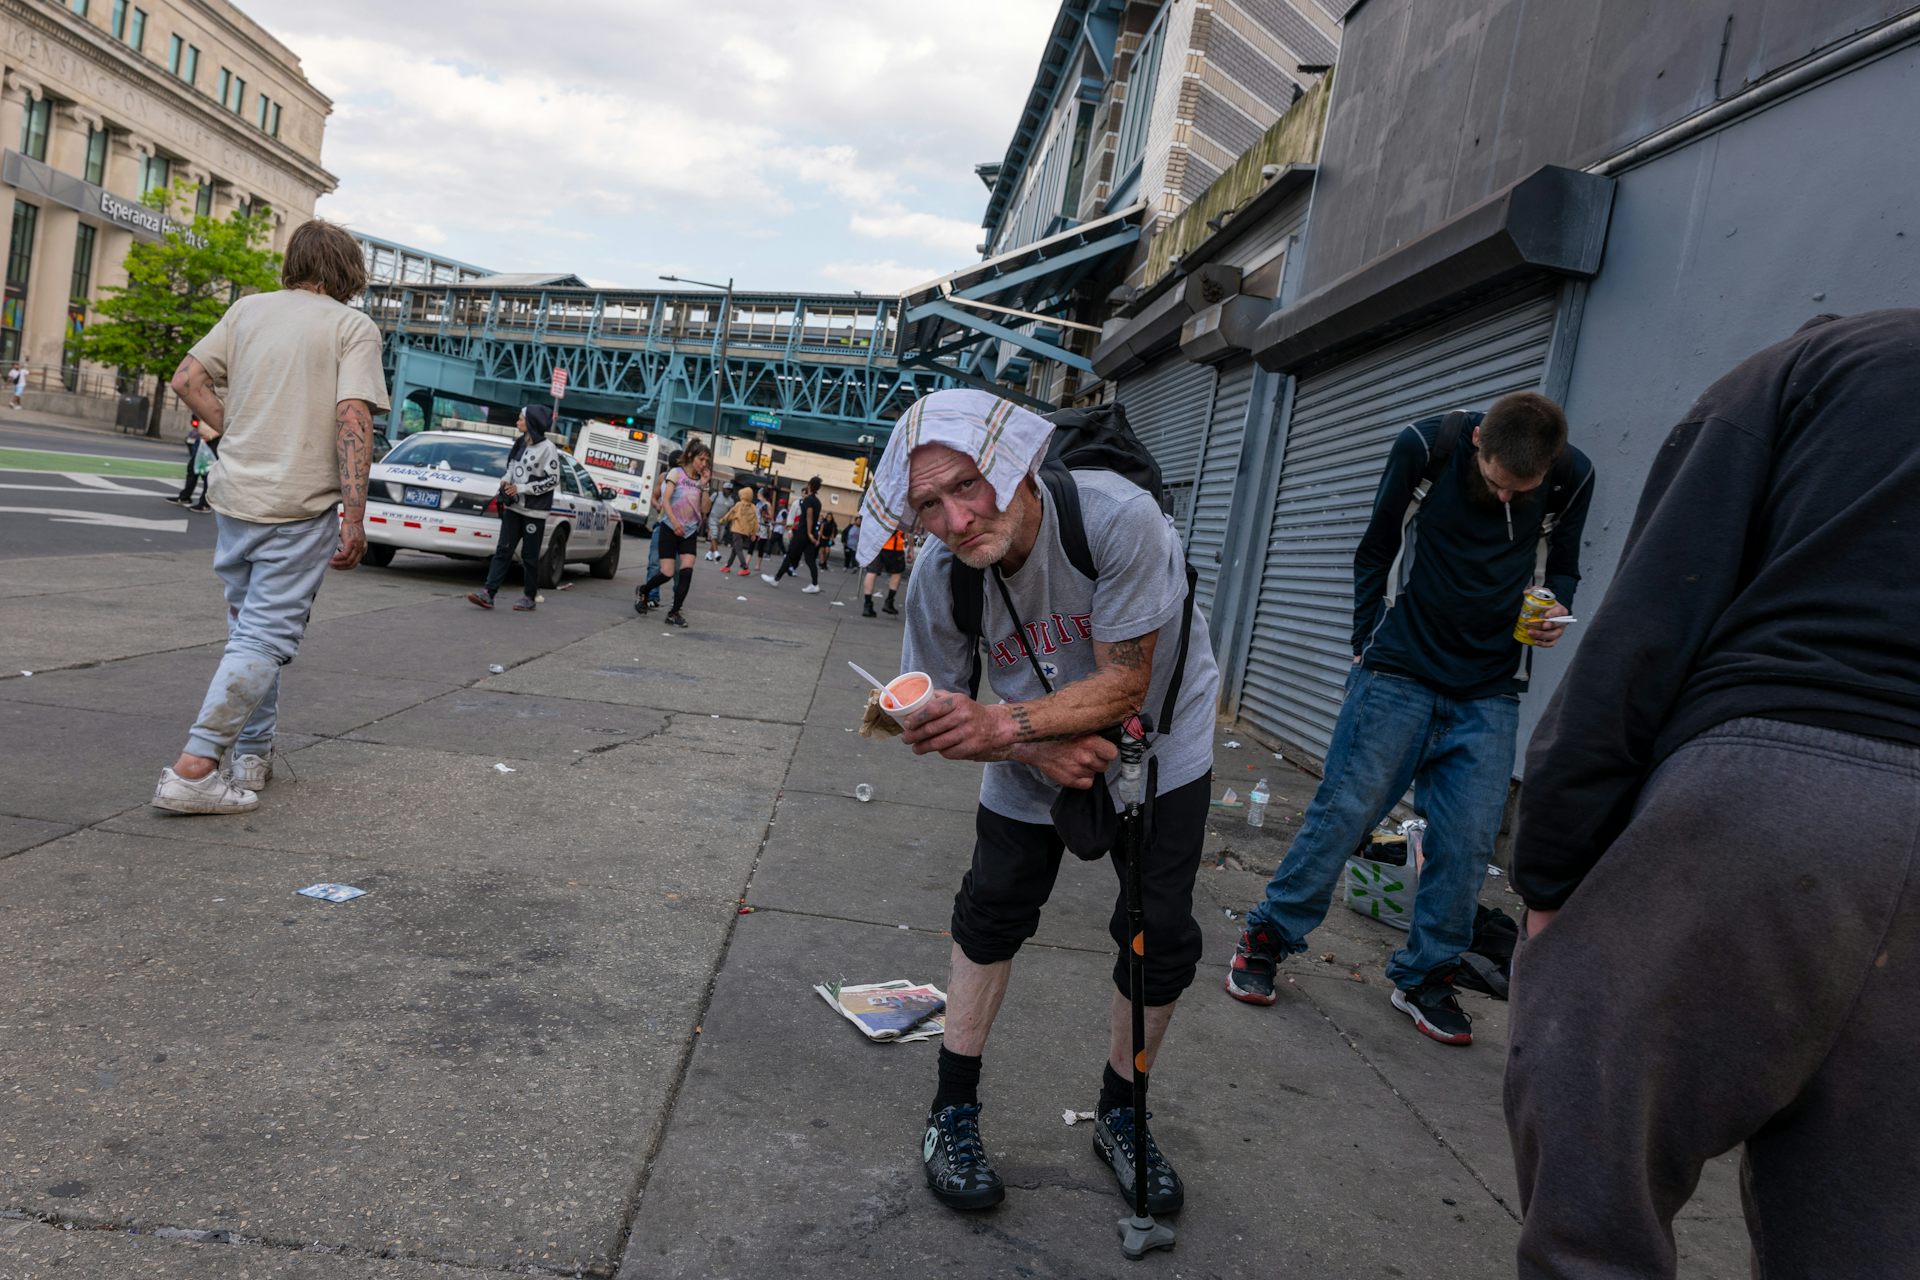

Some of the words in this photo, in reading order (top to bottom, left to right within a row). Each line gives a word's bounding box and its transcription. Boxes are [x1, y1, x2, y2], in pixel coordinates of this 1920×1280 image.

[101, 192, 160, 233] Esperanza
[588, 450, 630, 465] DEMAND
[386, 467, 427, 478] TRANSIT
[429, 471, 466, 484] POLICE
